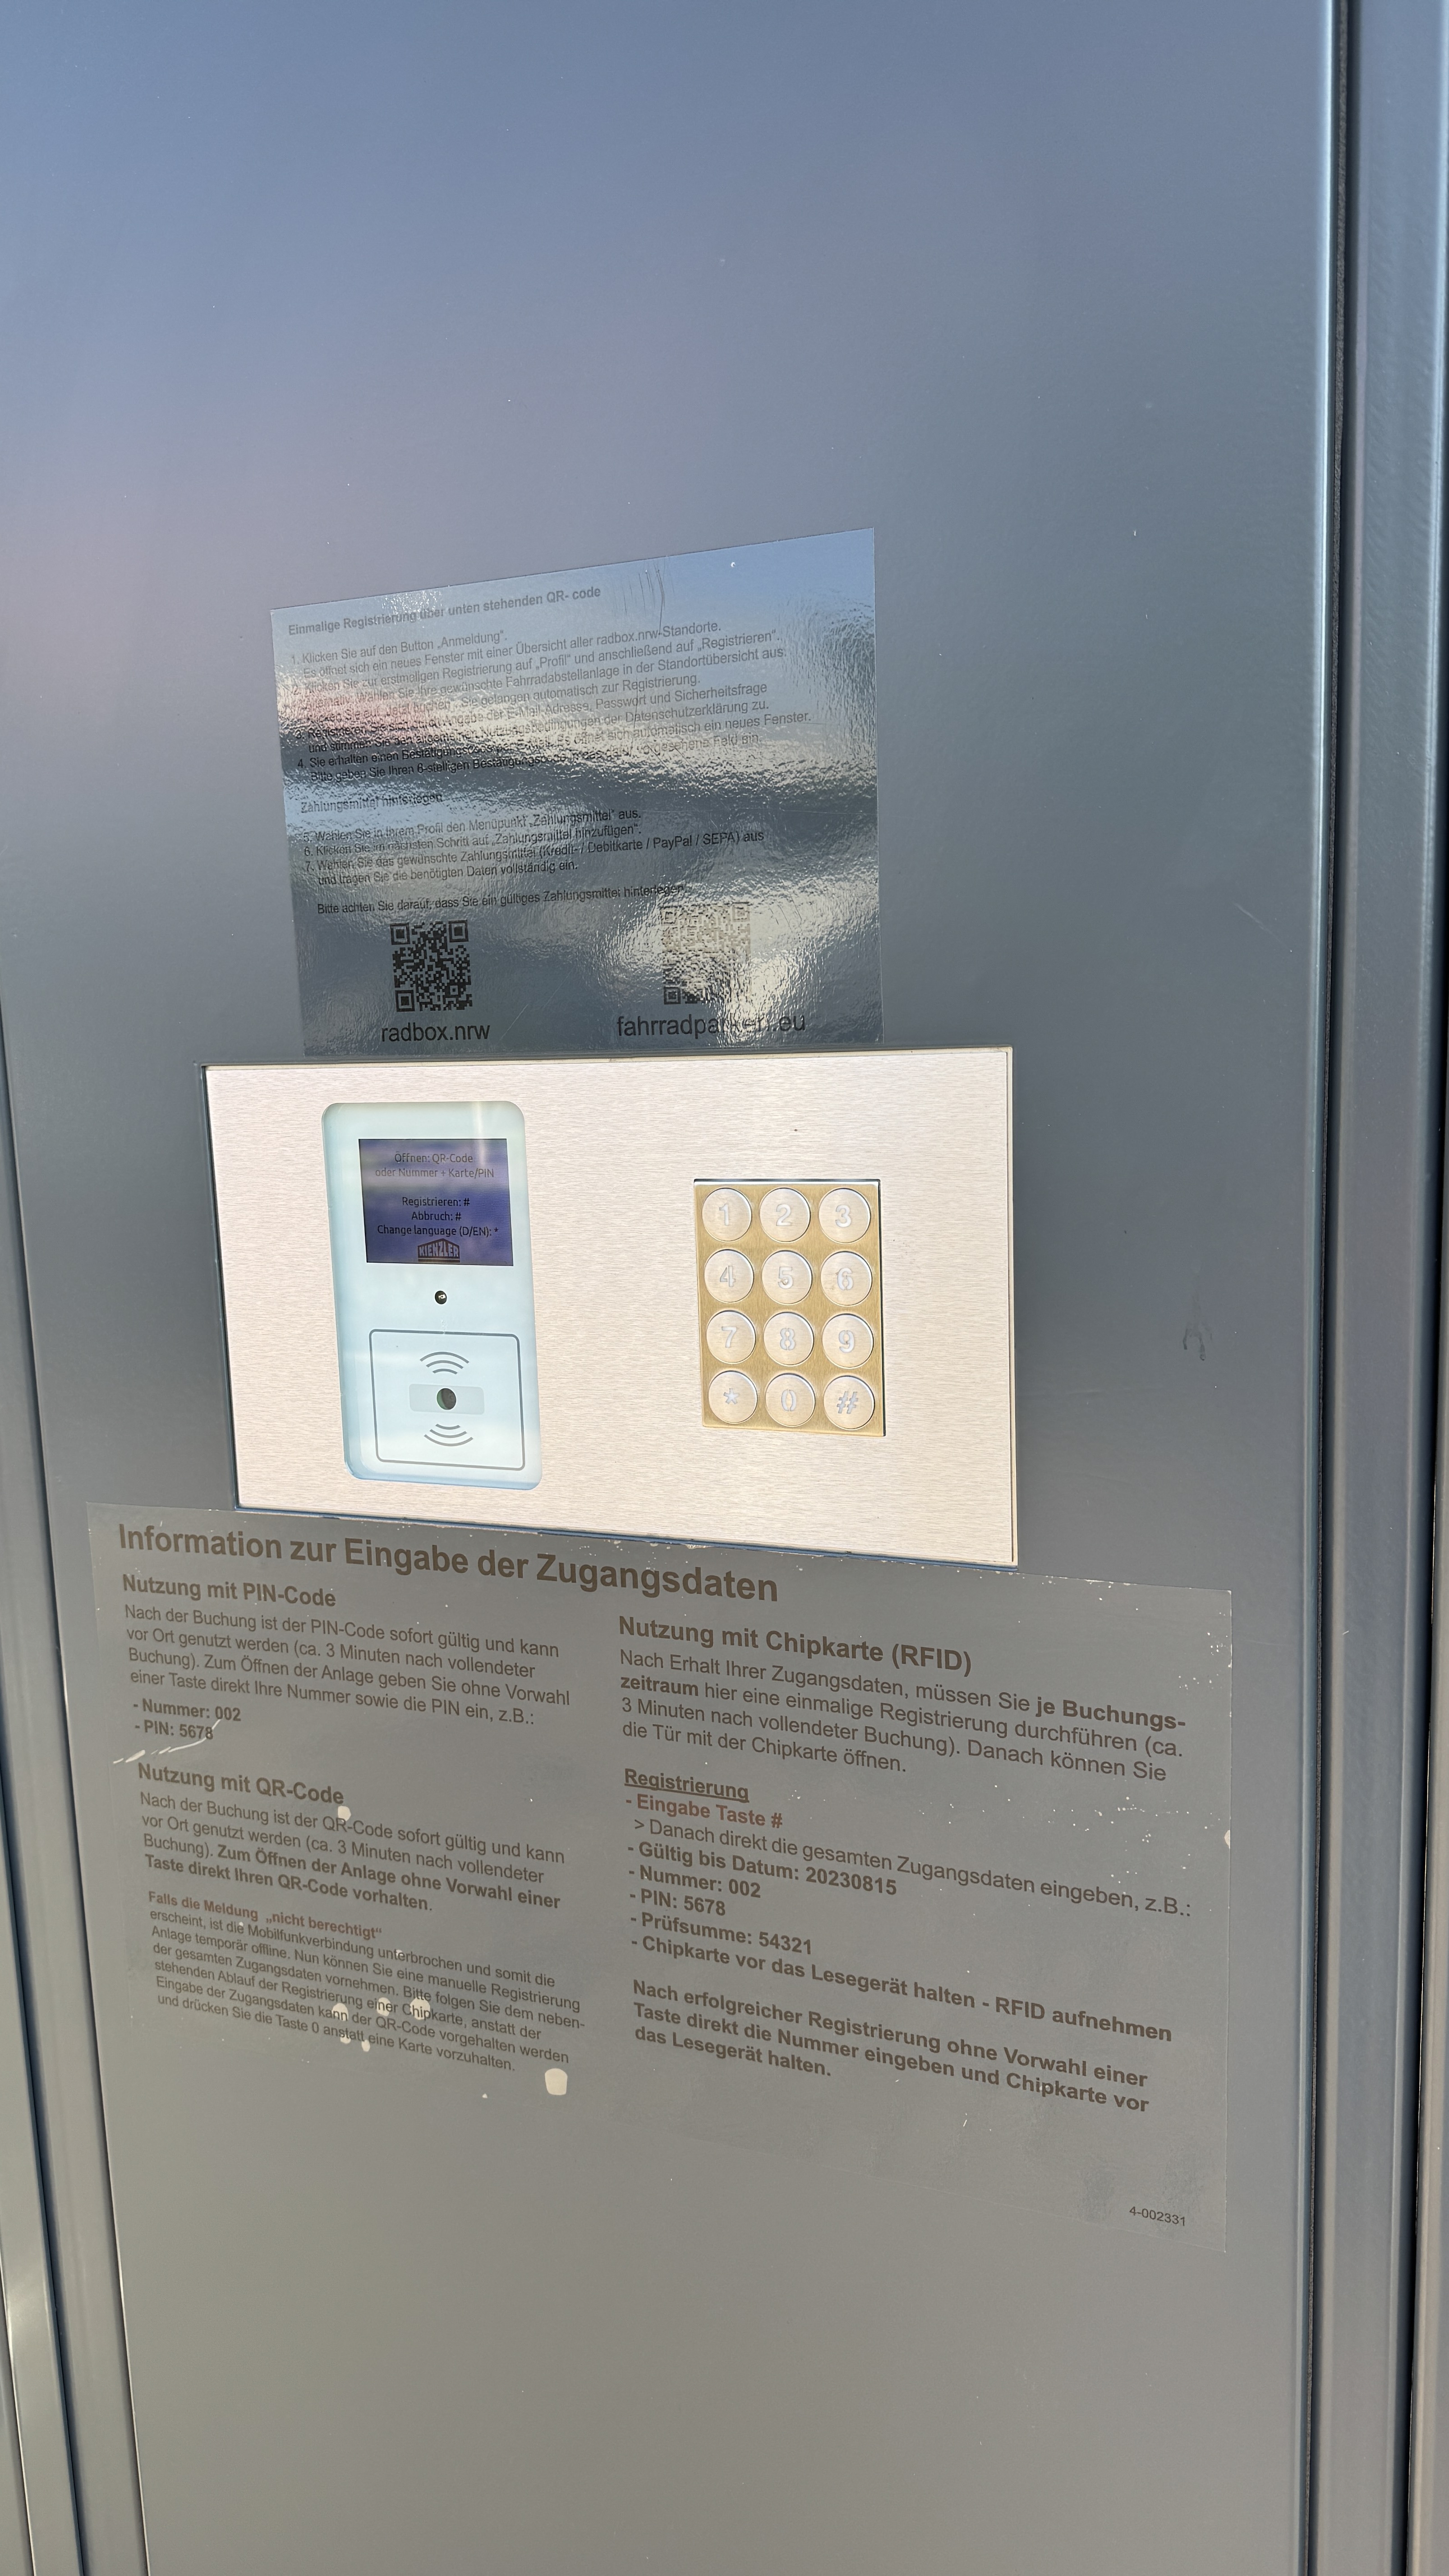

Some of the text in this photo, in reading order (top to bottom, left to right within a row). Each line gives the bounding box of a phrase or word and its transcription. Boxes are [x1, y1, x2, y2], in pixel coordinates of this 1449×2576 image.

[288, 620, 340, 636] Einmalige
[342, 611, 417, 630] Registrierung
[418, 606, 445, 620] über
[447, 602, 480, 616] unten
[483, 594, 543, 612] stehenden
[572, 585, 601, 600] code
[290, 654, 299, 666] 1.
[301, 650, 339, 664] Klicken
[340, 647, 357, 660] Sie
[359, 644, 377, 658] auf
[377, 643, 398, 655] den
[400, 639, 434, 653] Button
[303, 621, 722, 680] Es öffnet sich ein neues Fenster mit einer Übersicht aller radbox.nrw-Standorte.
[574, 650, 595, 664] und
[598, 641, 673, 662] anschließend
[675, 639, 695, 653] auf
[657, 649, 787, 672] Standortübersicht aus.
[595, 683, 767, 710] Passwort und Sicherheitsfrage
[724, 711, 812, 730] neues Fenster.
[587, 838, 644, 853] Debitkarte
[653, 834, 693, 851] PayPal
[500, 858, 579, 874] vollständig ein.
[317, 902, 340, 915] Bitte
[381, 1022, 490, 1043] radbox.nrw
[395, 1151, 473, 1163] Öffnen: QR-Code
[375, 1168, 395, 1177] oder
[399, 1168, 438, 1177] Nummer
[449, 1168, 494, 1179] Karte/PIN
[402, 1196, 470, 1208] Registrieren: #
[411, 1211, 462, 1221] Abbruch: #
[719, 1203, 851, 1228] 1 2 3
[377, 1225, 411, 1236] Change
[414, 1224, 456, 1237] language
[459, 1226, 492, 1237] (D/EN):
[419, 1241, 459, 1257] KIENZLER
[719, 1265, 853, 1291] 4 5 6
[721, 1326, 855, 1353] 7 8 9
[781, 1389, 796, 1412] 0
[836, 1391, 859, 1414] #
[118, 1523, 777, 1602] Information zur Eingabe der Zugangsdaten
[122, 1573, 336, 1607] Nutzung mit PIN-Code
[124, 1603, 559, 1658] Nach der Buchung ist der PIN-Code sofort gültig und kann
[619, 1615, 971, 1677] Nutzung mit Chipkarte (RFID)
[620, 1648, 1186, 1732] Nach Erhalt Ihrer Zugangsdaten, müssen Sie je Buchungs-
[142, 1697, 210, 1719] Nummer:
[214, 1705, 241, 1722] 002
[143, 1719, 174, 1736] PIN:
[179, 1723, 213, 1740] 5678
[138, 1762, 344, 1805] Nutzung mit QR-Code
[623, 1767, 750, 1803] Registrierung
[637, 1793, 710, 1818] Eingabe
[715, 1803, 765, 1826] Taste
[770, 1812, 783, 1829] #
[143, 1832, 561, 1909] Buchung). Zum Öffnen der Anlage ohne Vorwahl einer
[638, 1840, 693, 1868] Gültig
[698, 1849, 726, 1869] bis
[732, 1854, 799, 1880] Datum:
[805, 1866, 897, 1895] 20230815
[144, 1853, 432, 1911] Taste direkt Ihren QR-Code vorhalten.
[148, 1890, 178, 1906] Falls
[181, 1896, 200, 1910] die
[203, 1899, 258, 1922] Meldung
[308, 1916, 382, 1941] berechtigt“
[641, 1911, 752, 1945] Prüfsumme:
[758, 1931, 811, 1955] 54321
[157, 1995, 515, 2071] und drücken Sie die Taste 0 anstatt eine Karte vorzuhalten.
[1128, 2205, 1185, 2226] 4-002331
